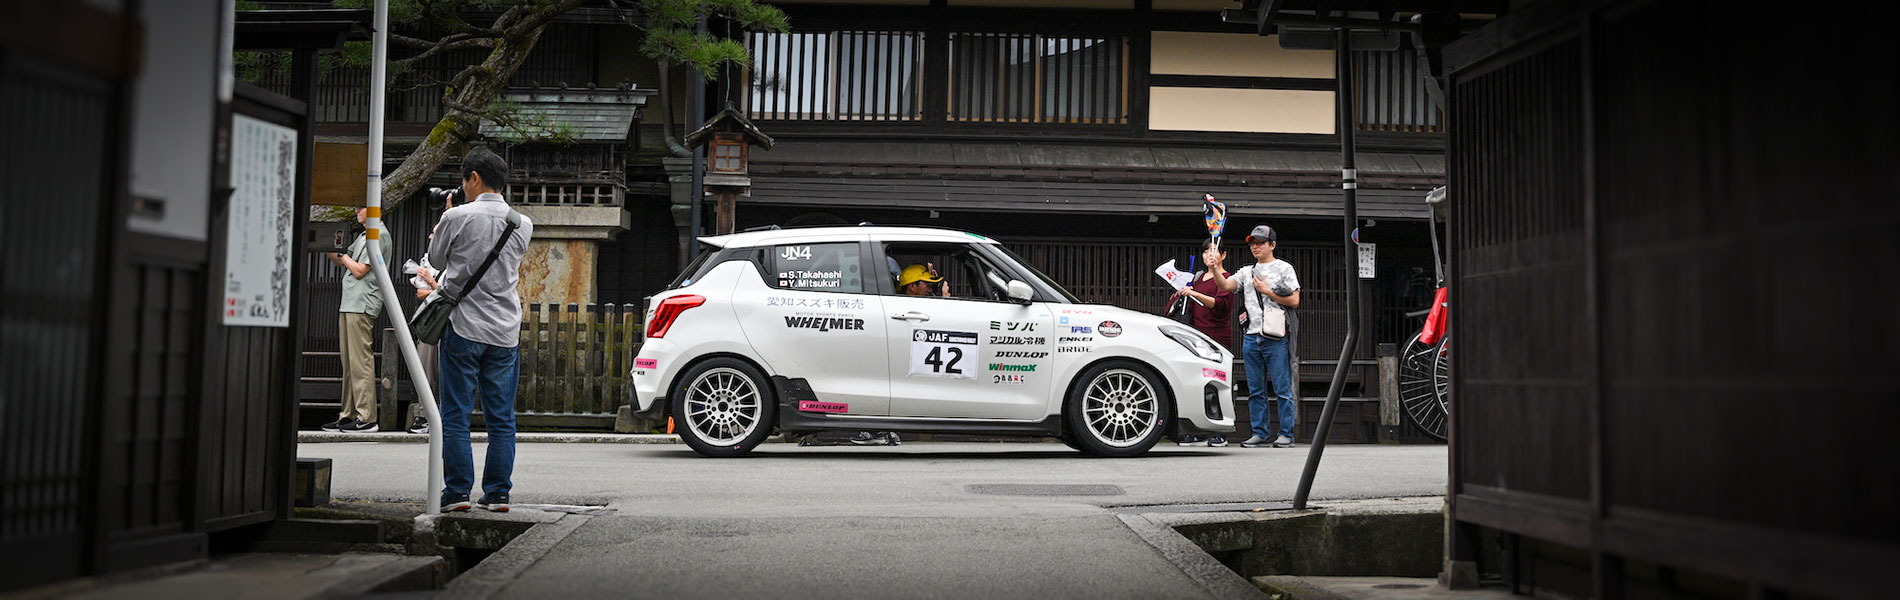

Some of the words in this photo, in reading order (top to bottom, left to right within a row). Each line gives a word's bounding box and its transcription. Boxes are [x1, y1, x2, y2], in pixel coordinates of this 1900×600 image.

[781, 246, 812, 260] JN4
[788, 270, 842, 279] S.Takahashi
[788, 279, 840, 288] Y.Mitsukuri
[784, 316, 865, 332] WHELMER
[990, 320, 1038, 331] ミツバ
[928, 332, 949, 342] JAF
[995, 351, 1049, 359] DUNLOP
[924, 346, 963, 375] 42
